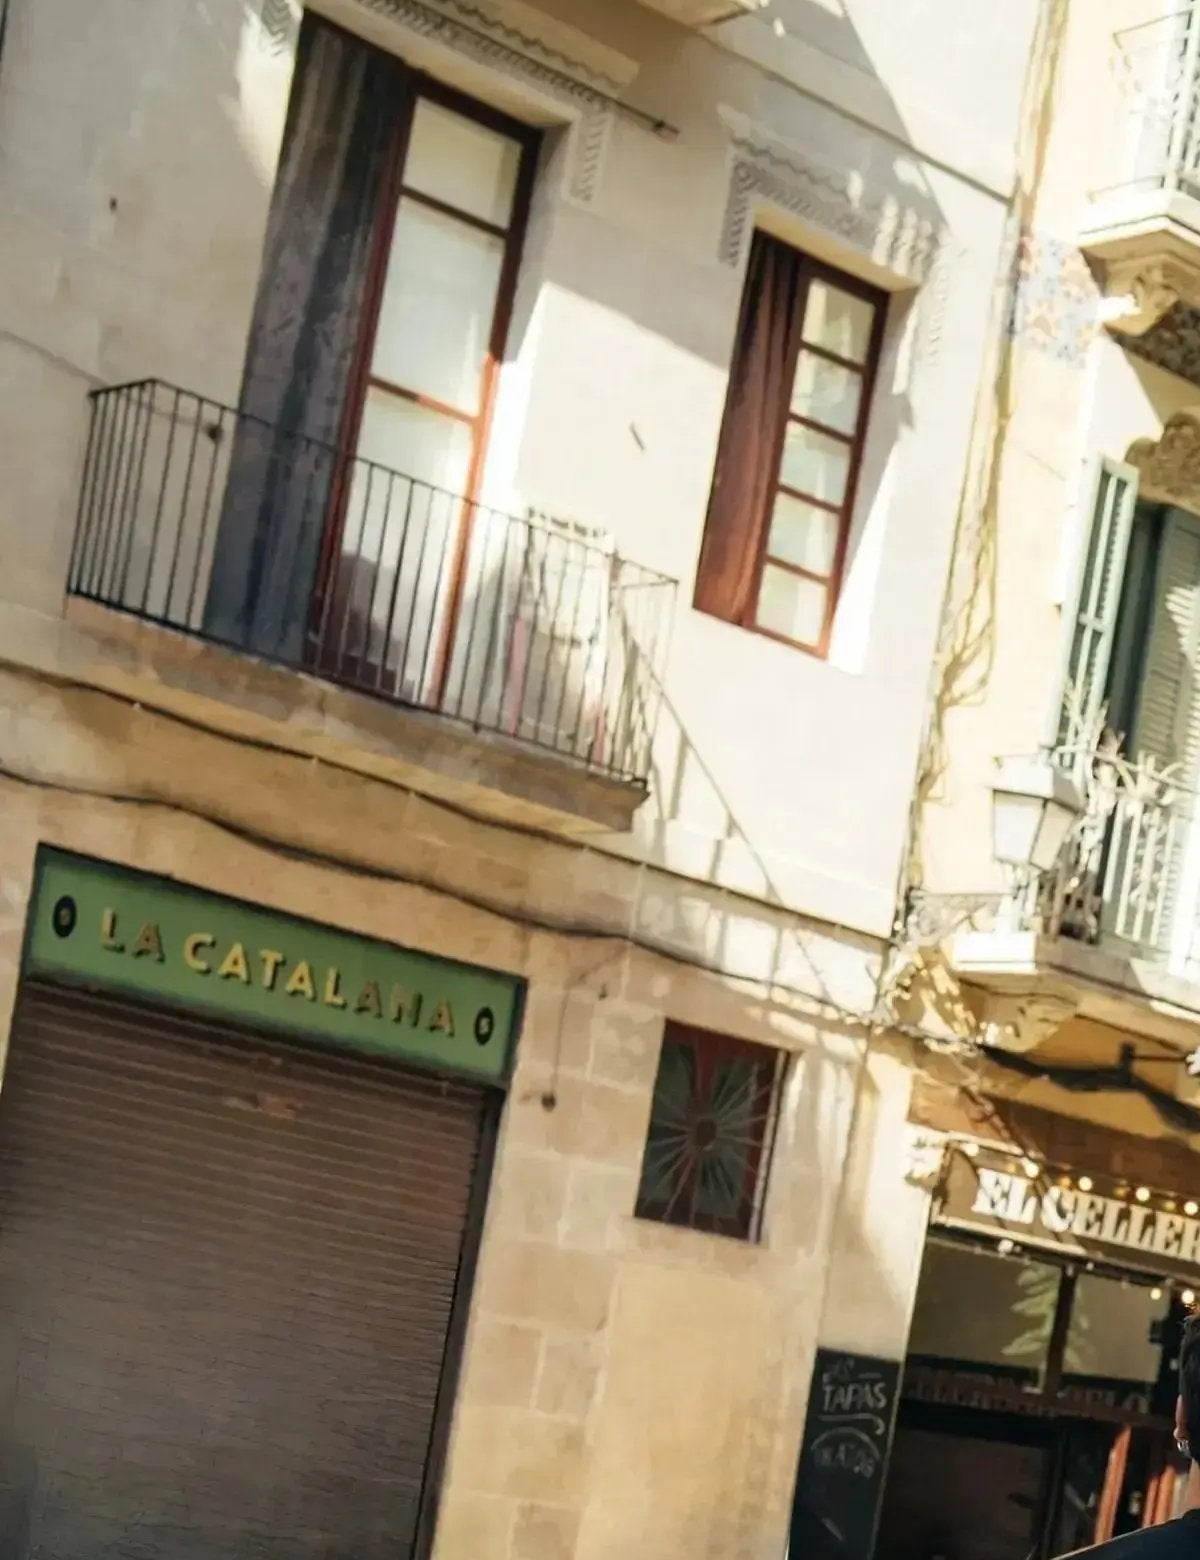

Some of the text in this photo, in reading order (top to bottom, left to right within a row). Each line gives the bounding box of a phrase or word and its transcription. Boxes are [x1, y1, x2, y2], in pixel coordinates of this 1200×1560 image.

[102, 908, 455, 1038] LA CATALANA
[971, 1167, 1038, 1224] EL
[822, 1382, 887, 1413] TAPAS
